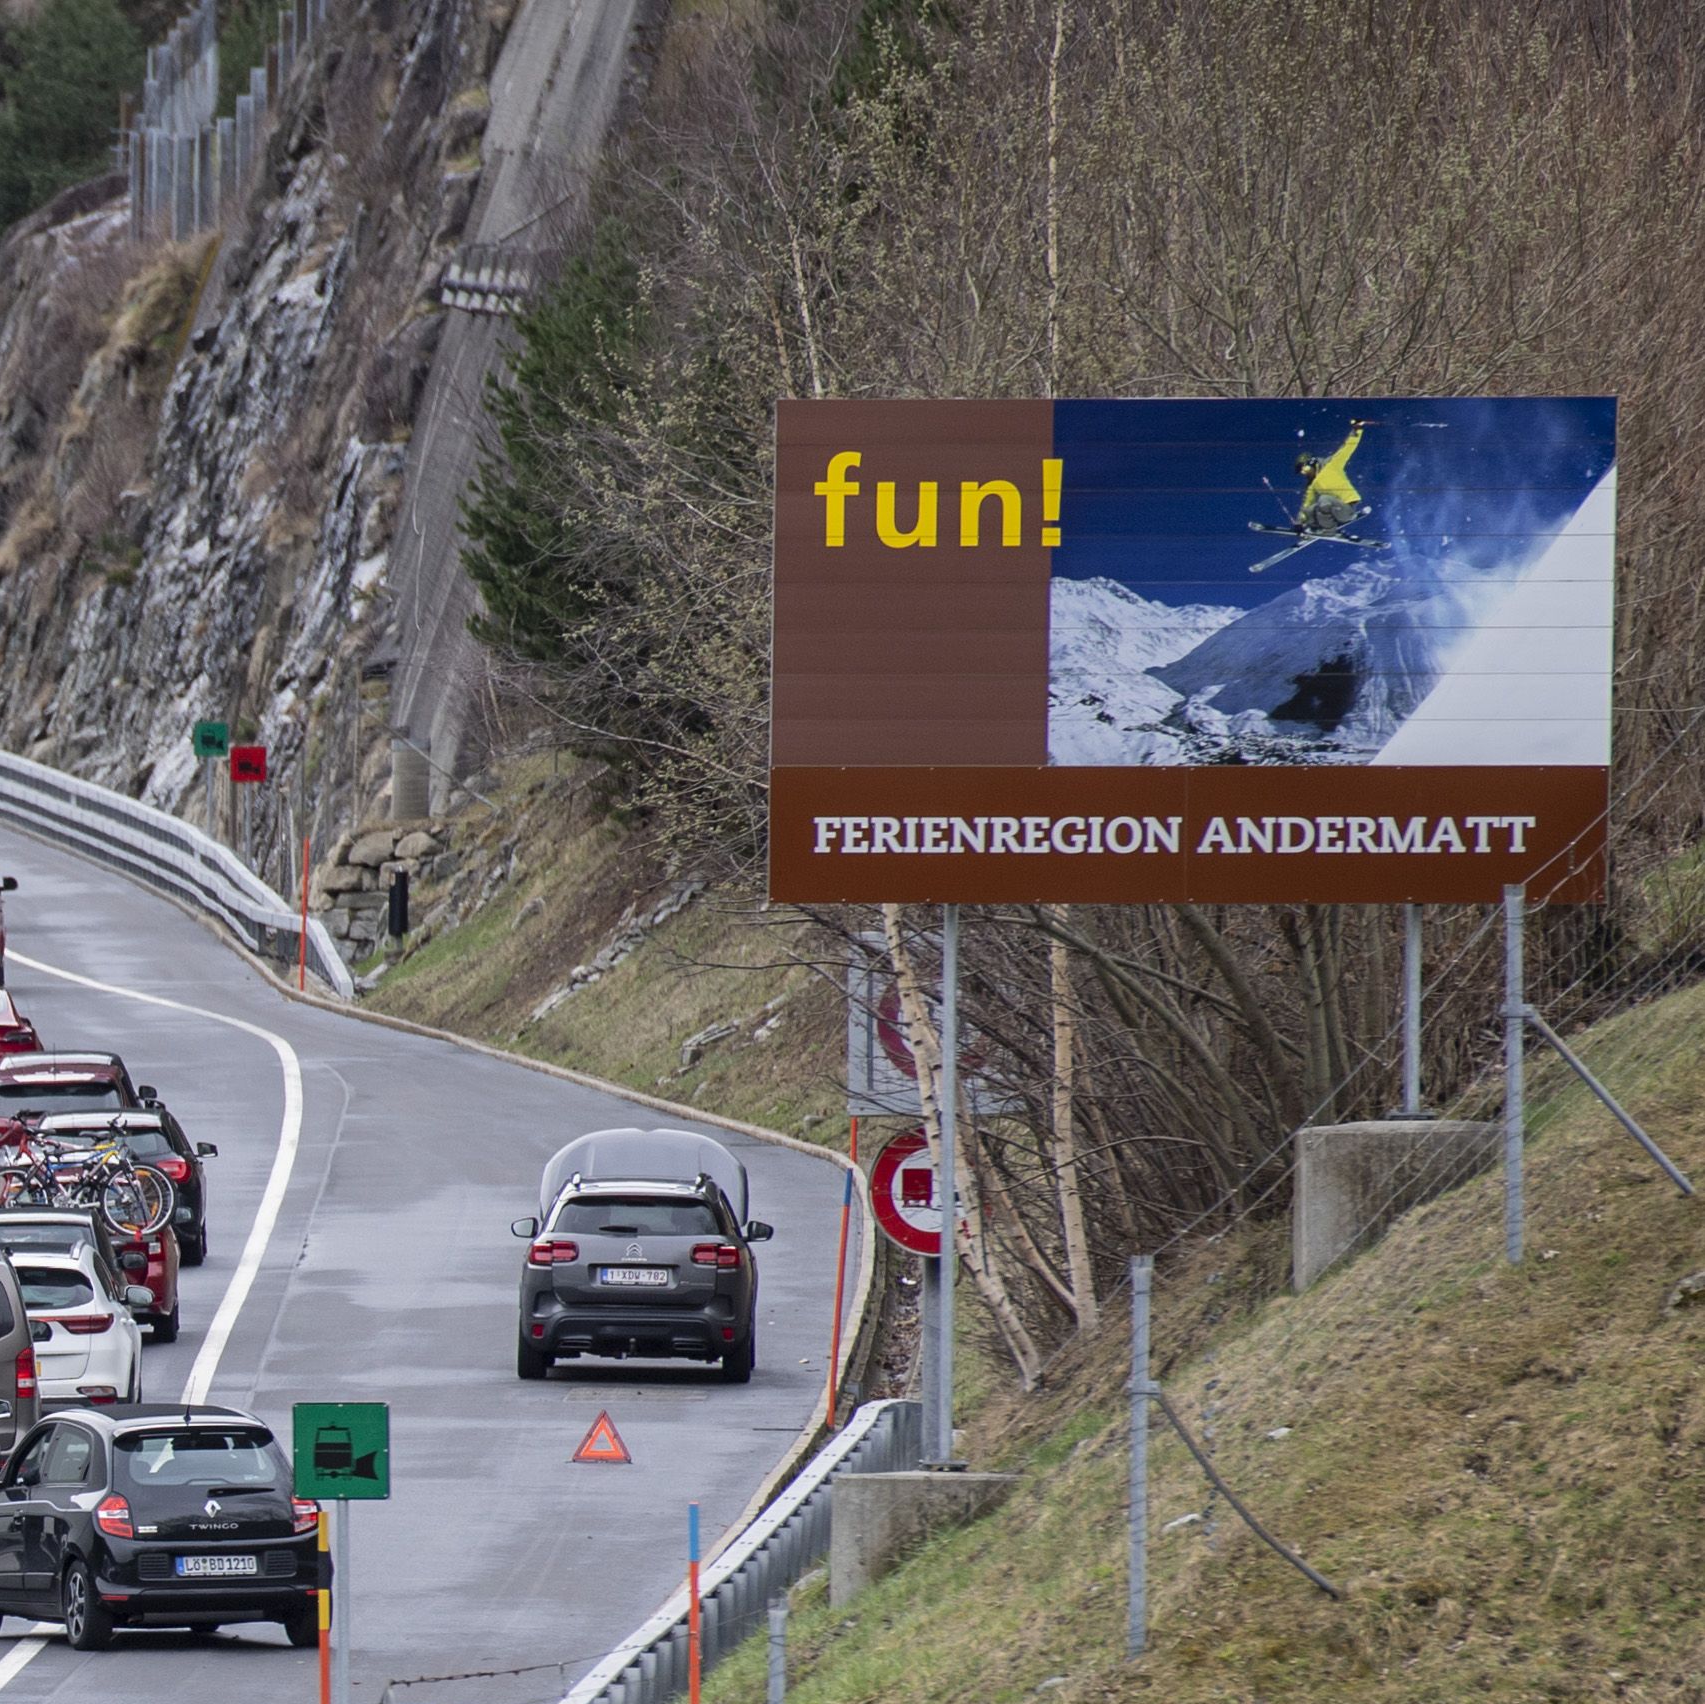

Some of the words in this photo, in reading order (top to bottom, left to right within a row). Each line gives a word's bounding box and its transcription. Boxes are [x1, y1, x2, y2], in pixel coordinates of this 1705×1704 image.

[813, 451, 1065, 549] fun!
[812, 816, 1183, 857] FERIENREGION
[1195, 816, 1537, 857] ANDERMATT
[186, 1559, 201, 1571] LÖ
[211, 1558, 224, 1571] BD
